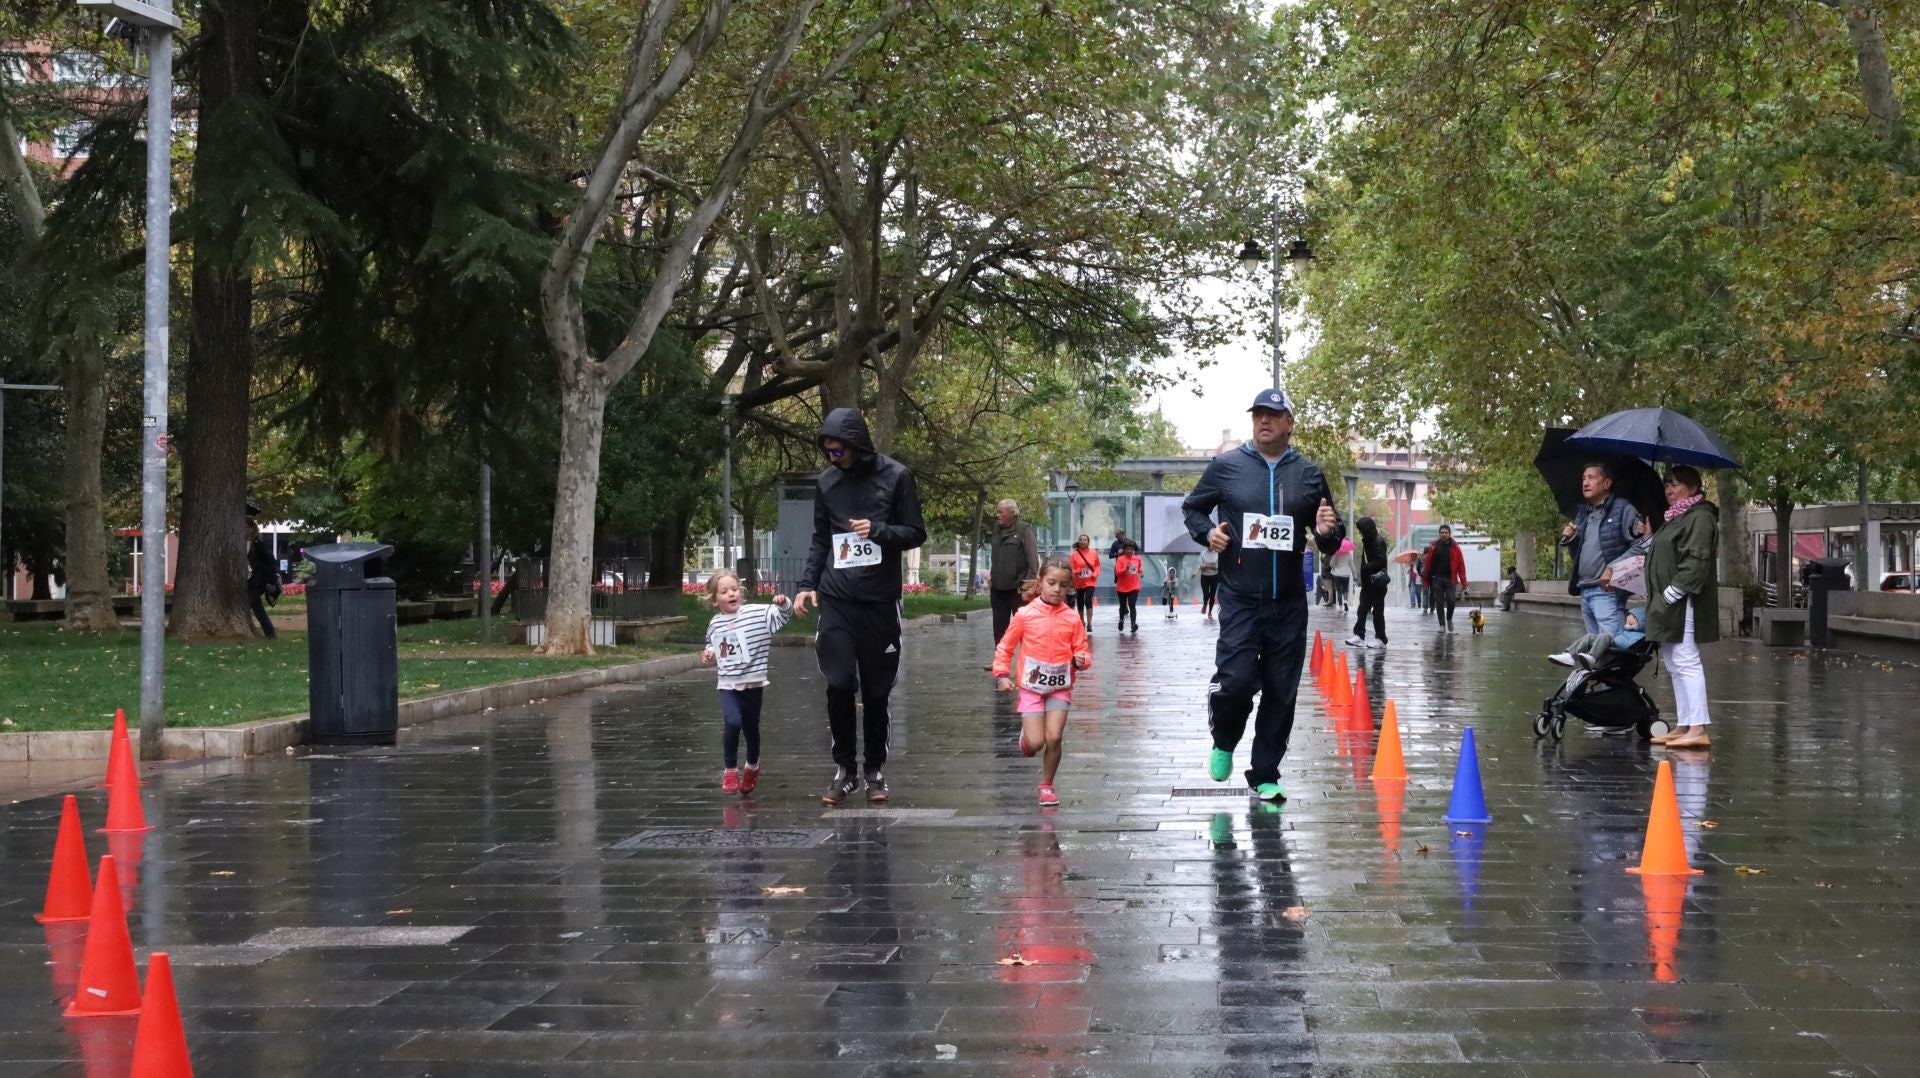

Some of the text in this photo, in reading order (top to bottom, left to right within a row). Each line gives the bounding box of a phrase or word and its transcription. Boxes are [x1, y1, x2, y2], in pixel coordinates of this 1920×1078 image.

[1262, 527, 1290, 541] 182
[853, 543, 872, 556] 36
[1038, 673, 1066, 687] 288
